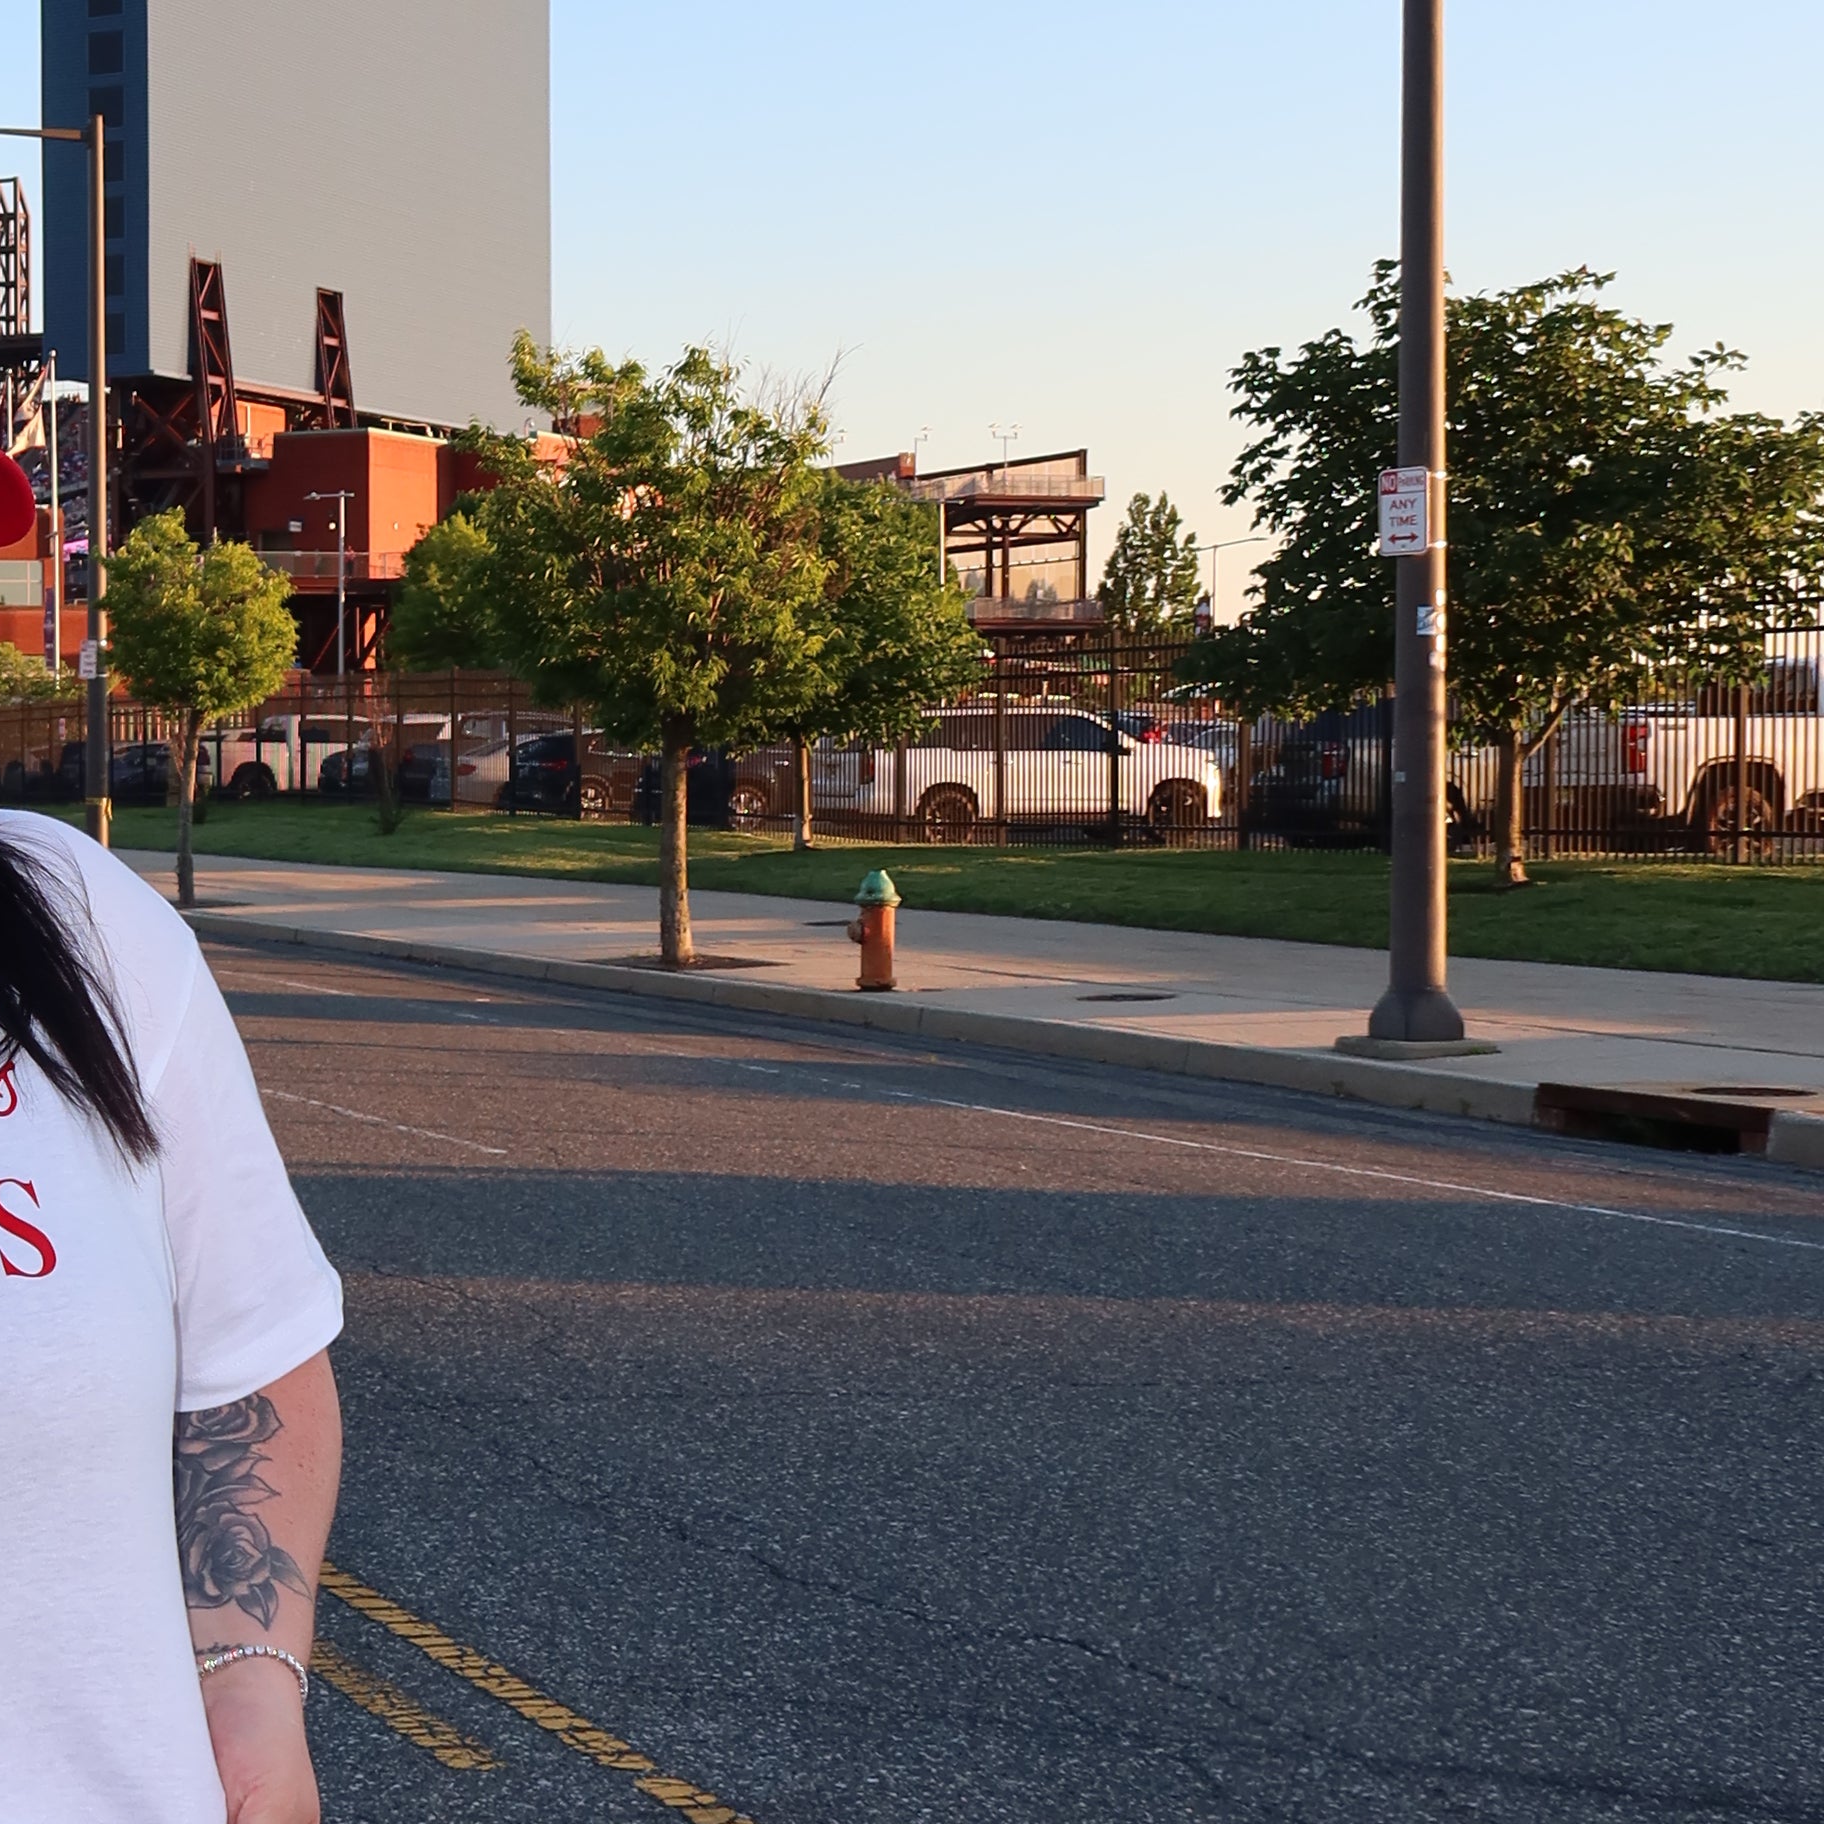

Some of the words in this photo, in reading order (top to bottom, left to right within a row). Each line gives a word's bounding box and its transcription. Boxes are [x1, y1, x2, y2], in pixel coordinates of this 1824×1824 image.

[1381, 474, 1396, 491] NO
[1389, 498, 1418, 511] ANY
[1389, 514, 1418, 527] TIME
